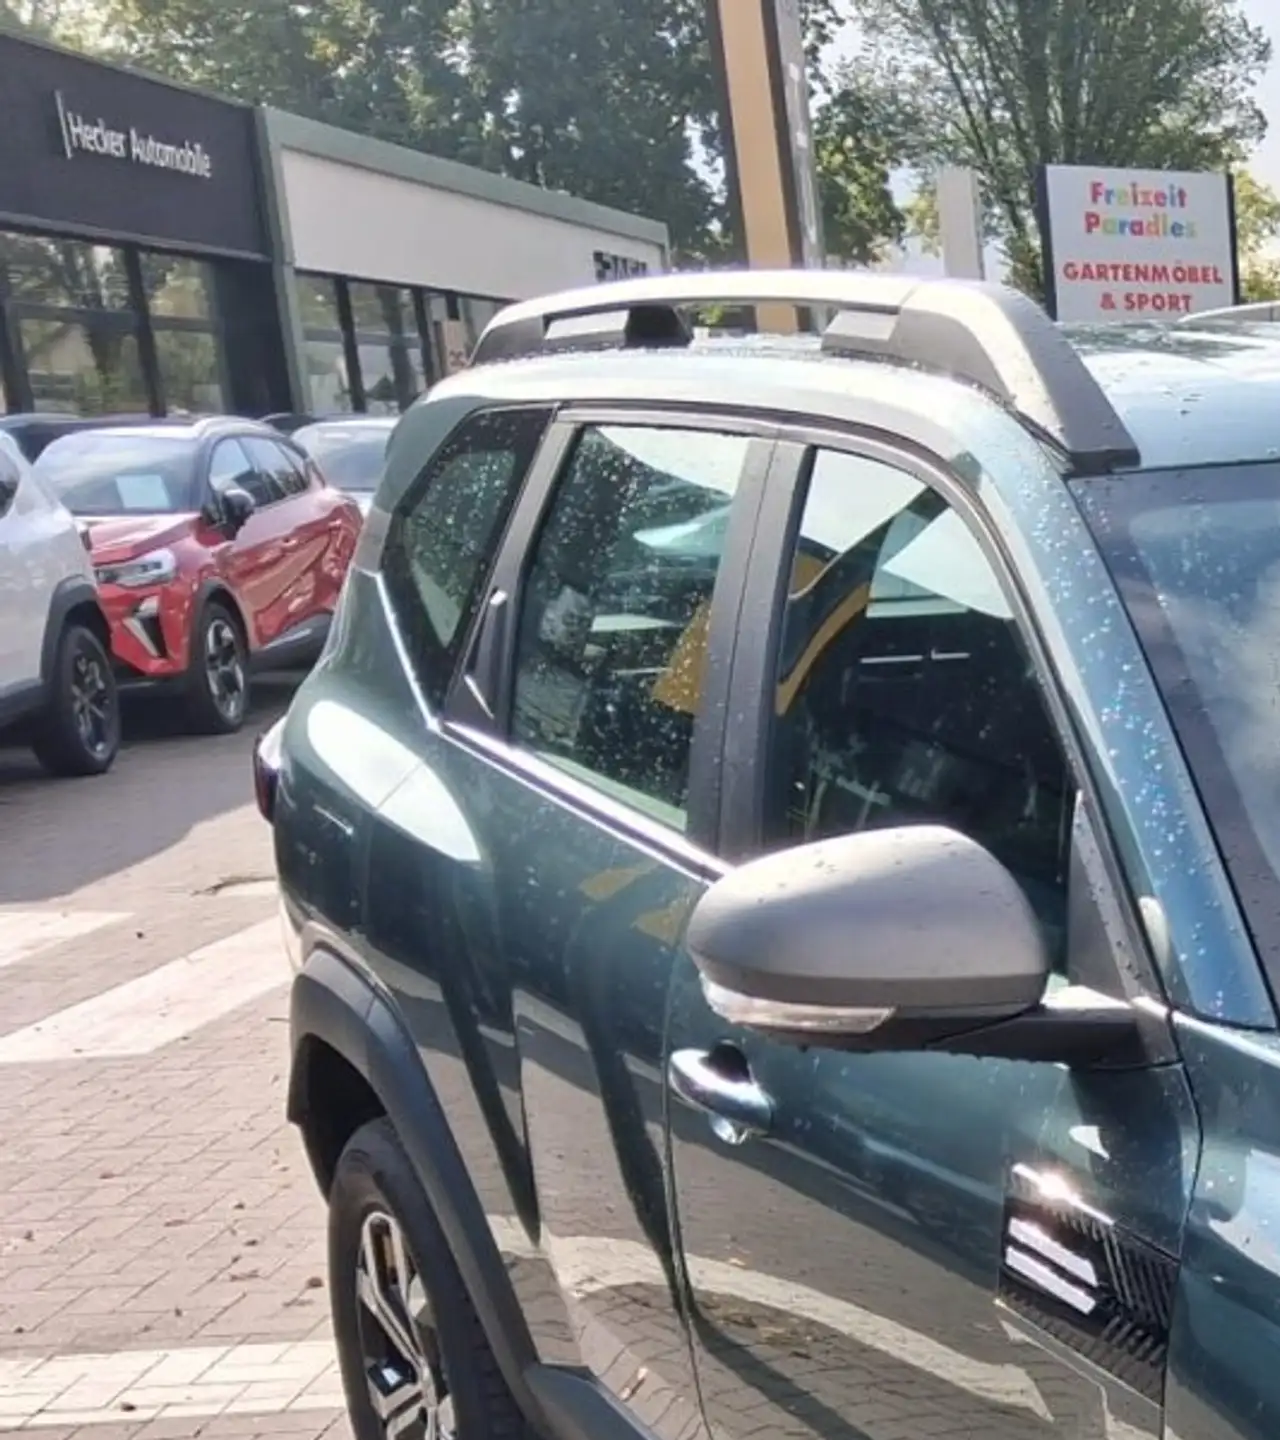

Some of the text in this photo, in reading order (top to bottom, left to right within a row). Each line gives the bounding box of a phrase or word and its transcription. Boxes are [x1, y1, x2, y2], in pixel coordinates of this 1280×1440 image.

[66, 111, 212, 179] Hecker Automobile
[1090, 182, 1188, 208] Freizeit
[1085, 211, 1198, 238] Paradies
[1063, 260, 1224, 285] GARTENMÖBEL
[1100, 293, 1193, 313] & SPORT
